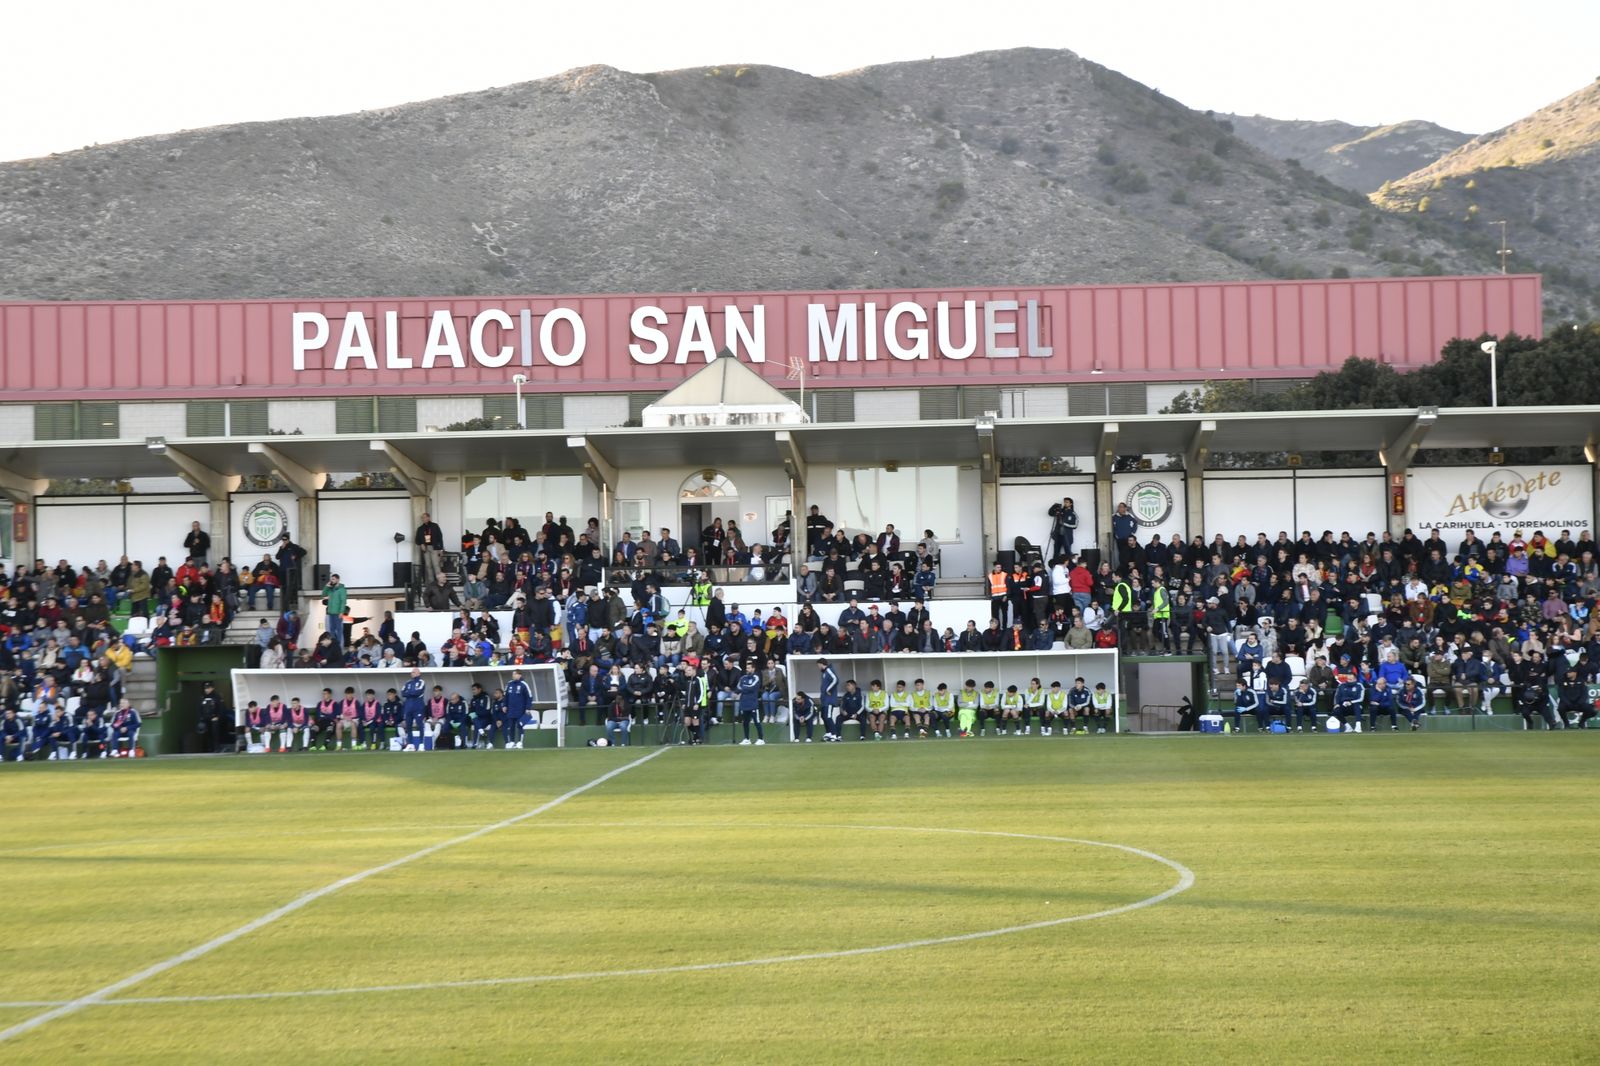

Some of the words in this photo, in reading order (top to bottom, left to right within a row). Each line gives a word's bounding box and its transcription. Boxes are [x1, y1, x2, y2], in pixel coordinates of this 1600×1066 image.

[292, 307, 587, 371] PALACIO
[628, 304, 766, 365] SAN
[807, 299, 1054, 363] MIGUEL
[1444, 469, 1562, 518] Atrévete
[1419, 522, 1432, 530] LA
[1436, 521, 1494, 530] CARIHUELA
[1504, 520, 1588, 530] TORREMOLINOS
